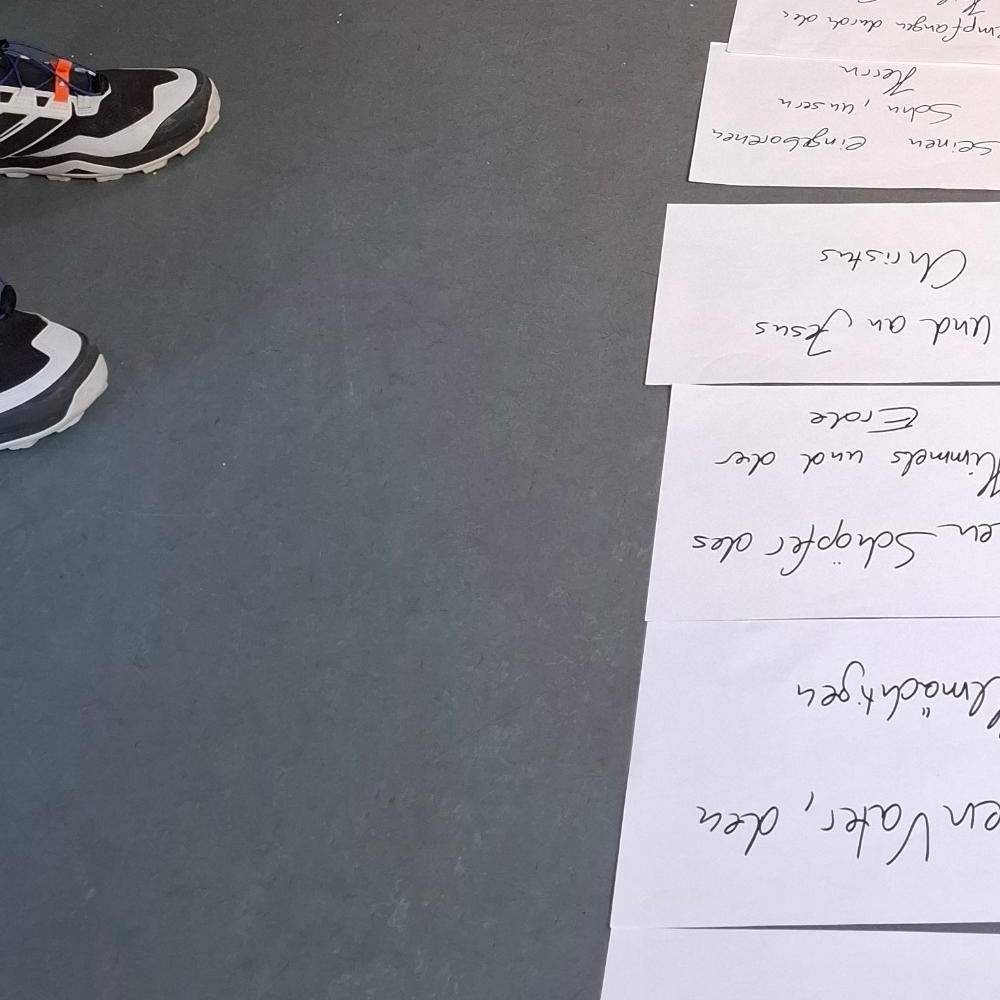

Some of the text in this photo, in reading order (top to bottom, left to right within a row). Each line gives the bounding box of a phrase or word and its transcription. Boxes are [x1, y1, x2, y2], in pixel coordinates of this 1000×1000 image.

[827, 16, 882, 32] durch
[840, 66, 916, 96] Herrn
[778, 98, 854, 114] unsern
[712, 128, 866, 152] eingeborenen
[819, 249, 967, 289] Christus
[755, 309, 852, 356] Jesus
[868, 316, 906, 334] an
[810, 407, 918, 433] Erde
[714, 451, 776, 475] der
[802, 450, 863, 473] und
[692, 532, 753, 563] des
[764, 520, 937, 576] Schöpfer
[696, 806, 779, 856] den
[805, 791, 930, 866] Vater,
